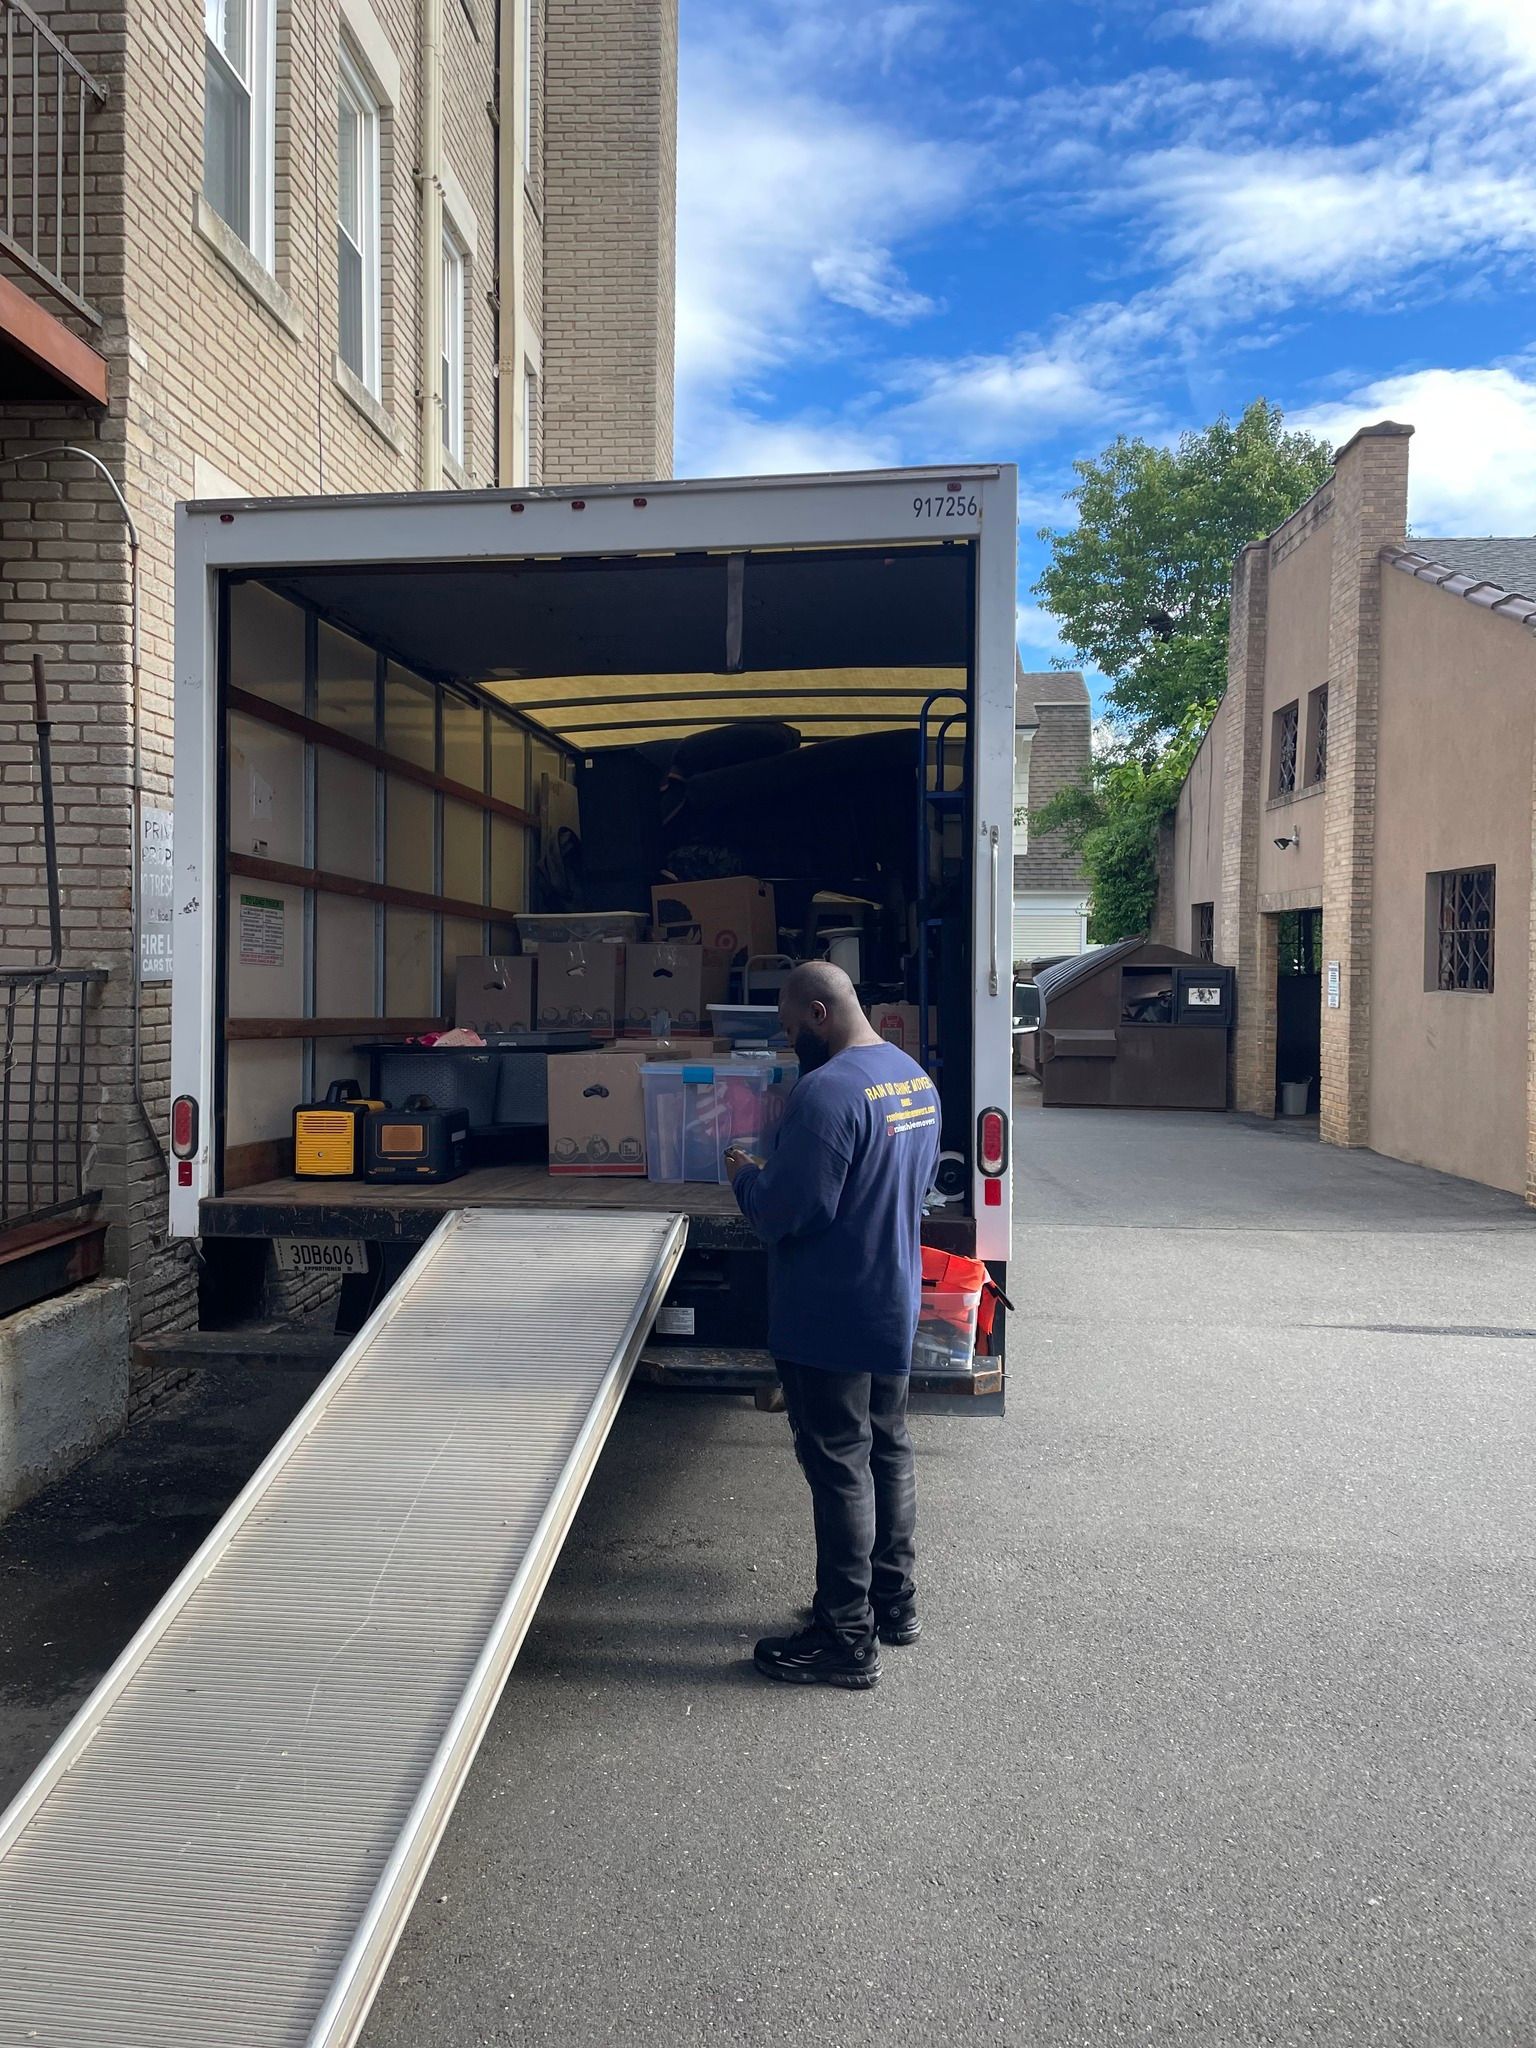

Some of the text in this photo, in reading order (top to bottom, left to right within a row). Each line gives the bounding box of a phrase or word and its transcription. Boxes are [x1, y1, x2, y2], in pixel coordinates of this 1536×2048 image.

[913, 496, 978, 518] 917256
[141, 934, 164, 955] FIRE
[142, 958, 164, 972] CARS
[864, 1084, 888, 1102] RAIN
[290, 1245, 354, 1265] 3DB606
